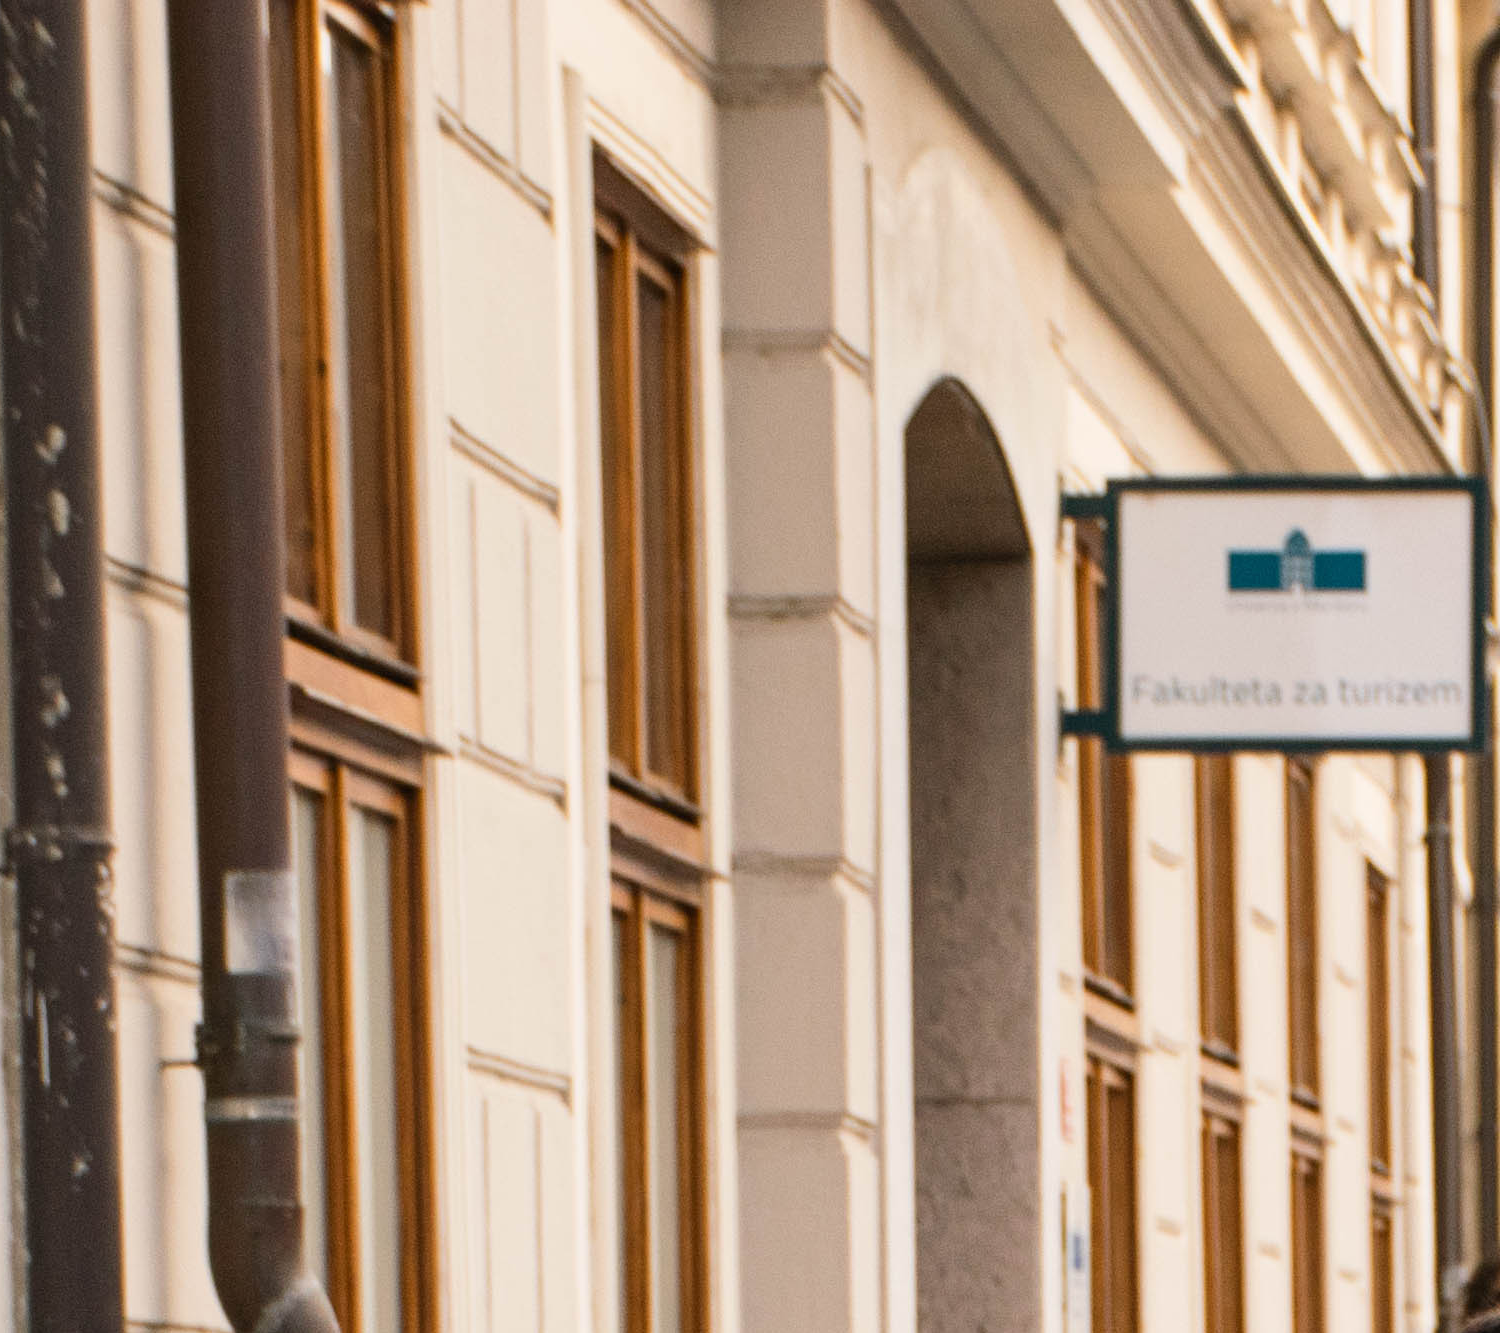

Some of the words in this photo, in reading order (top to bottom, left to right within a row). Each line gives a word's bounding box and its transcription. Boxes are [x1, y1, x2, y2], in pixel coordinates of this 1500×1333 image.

[1130, 674, 1282, 706] Fakulteta
[1292, 682, 1328, 706] za
[1337, 676, 1463, 706] turizem
